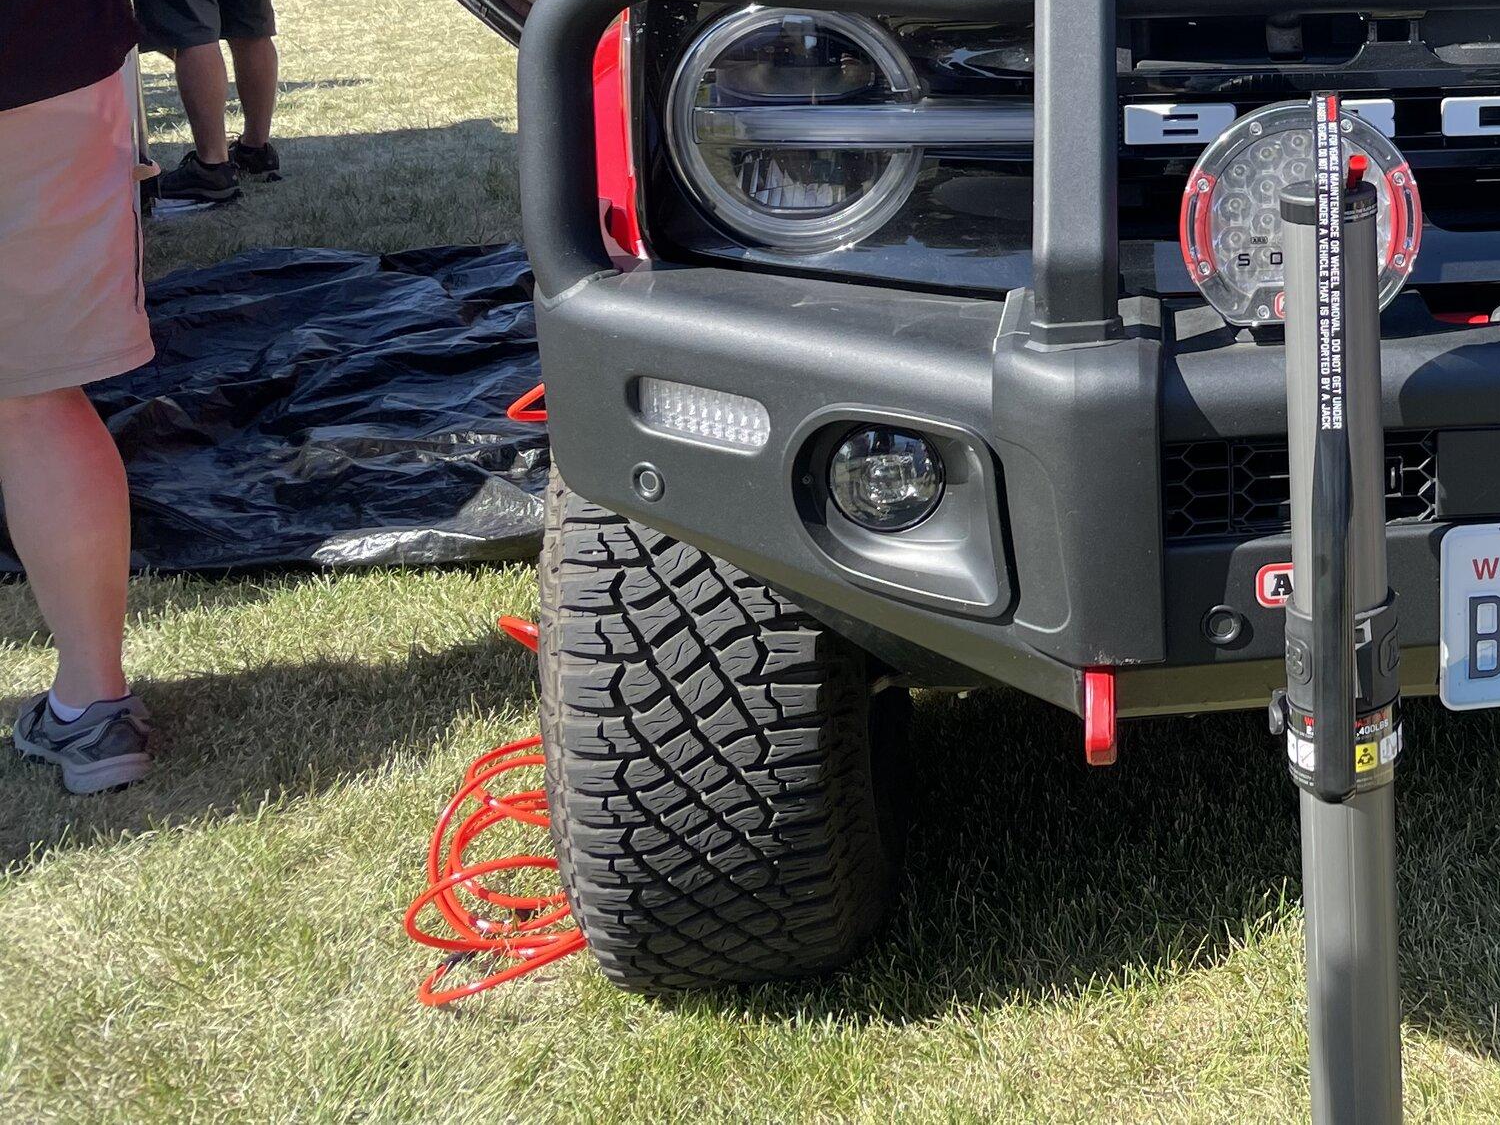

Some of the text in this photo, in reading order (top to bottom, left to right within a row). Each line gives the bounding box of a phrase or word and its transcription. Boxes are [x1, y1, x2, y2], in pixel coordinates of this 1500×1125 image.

[1329, 145, 1339, 171] VEHICLE
[1318, 172, 1328, 191] GET
[1318, 194, 1329, 226] UNDER
[1330, 172, 1340, 238] MAINTENANCE
[1319, 228, 1329, 236] A
[1319, 237, 1329, 273] VEHICLE
[1330, 240, 1340, 253] OR
[1330, 254, 1341, 288] WHEEL
[1319, 279, 1329, 304] THAT
[1319, 306, 1330, 316] IS
[1320, 318, 1331, 376] SUPPORTED
[1331, 339, 1341, 353] DO
[1332, 355, 1342, 374] NOT
[1321, 377, 1331, 391] BY
[1332, 376, 1342, 394] GET
[1321, 393, 1331, 401] A
[1321, 404, 1331, 431] JACK
[1332, 396, 1343, 430] UNDER
